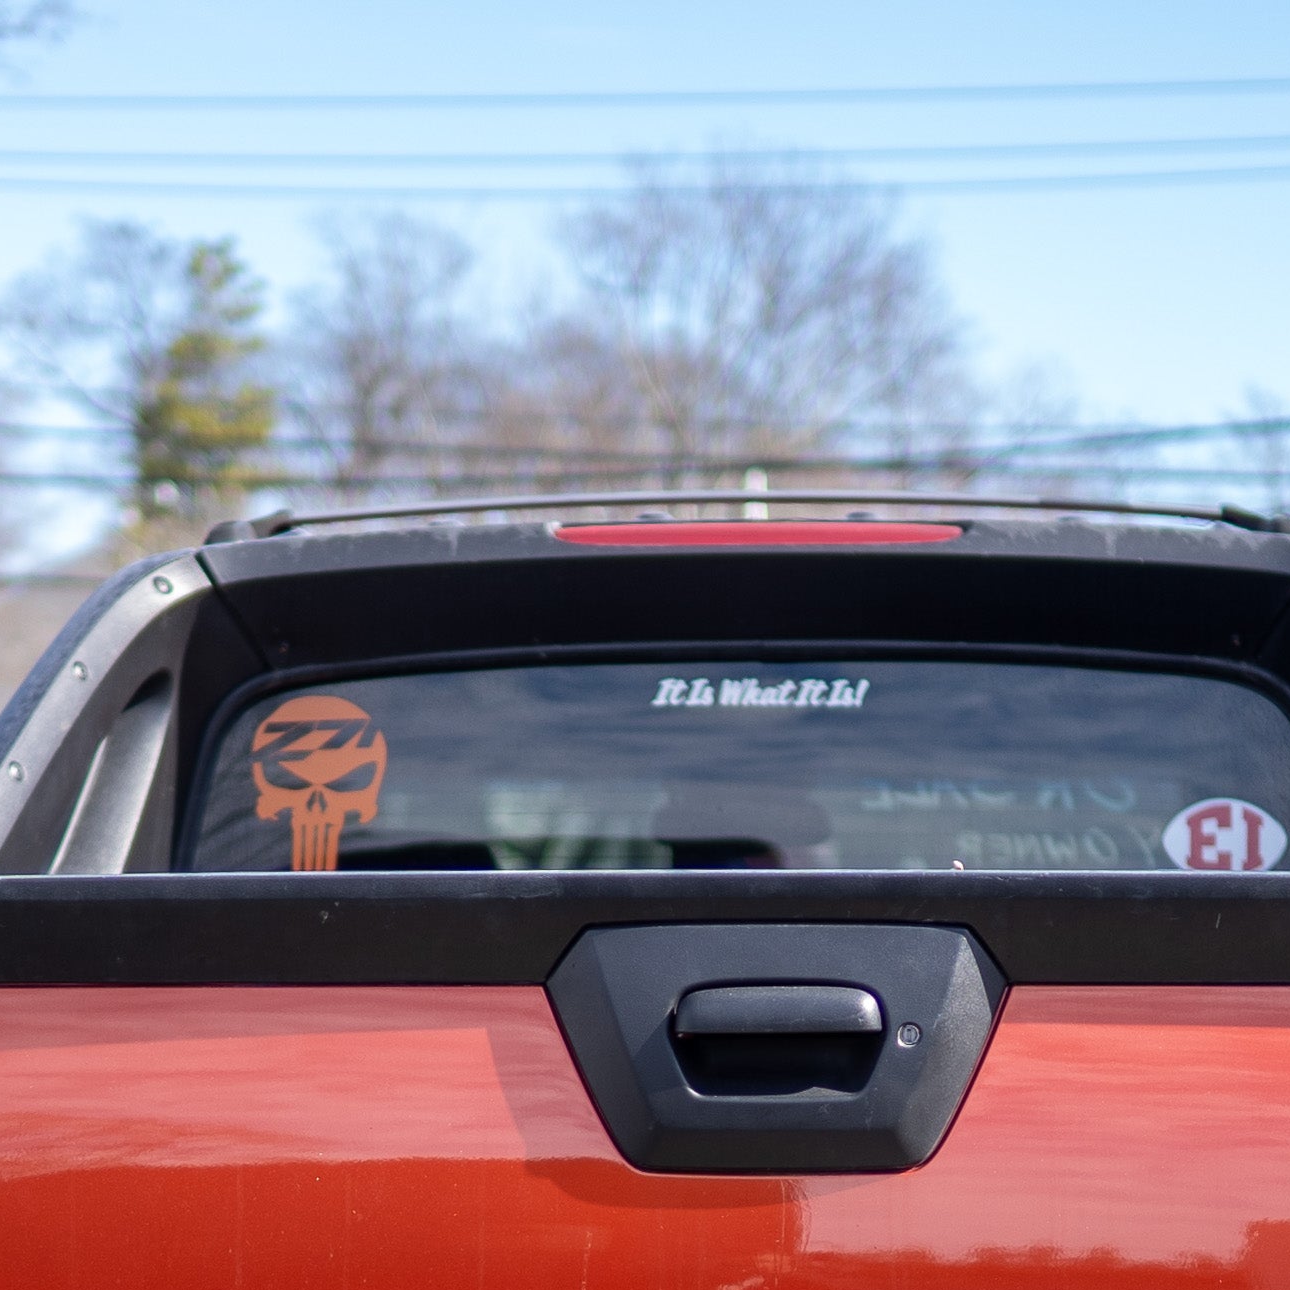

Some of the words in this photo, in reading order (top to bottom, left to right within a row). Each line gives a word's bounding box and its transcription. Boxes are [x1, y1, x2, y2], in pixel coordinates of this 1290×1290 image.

[651, 678, 689, 706] It
[685, 678, 715, 706] Is
[718, 678, 797, 706] What
[793, 678, 829, 707] It
[826, 678, 870, 707] Is!
[1186, 803, 1264, 871] EI
